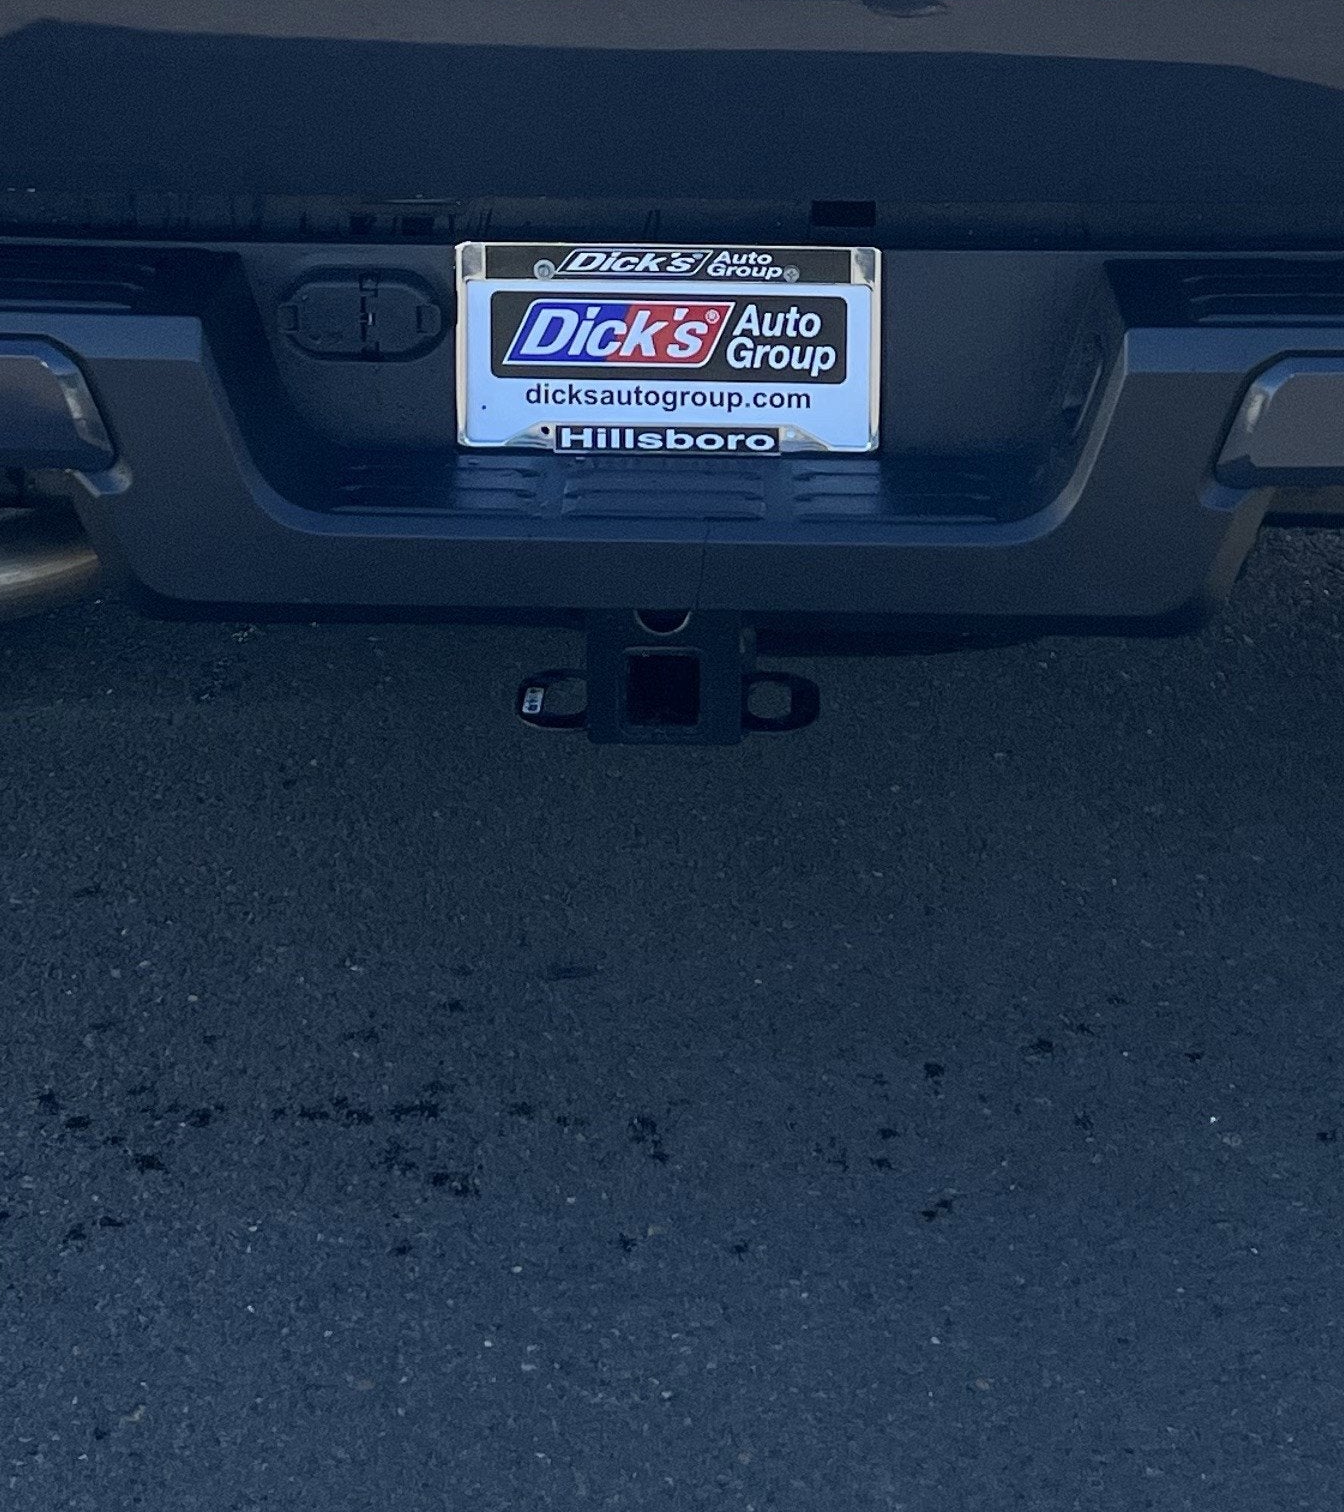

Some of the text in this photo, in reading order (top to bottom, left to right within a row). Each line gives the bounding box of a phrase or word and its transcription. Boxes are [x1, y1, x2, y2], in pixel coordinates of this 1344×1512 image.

[566, 250, 704, 274] Dick's
[706, 262, 783, 280] Group
[713, 251, 773, 266] Auto
[731, 305, 823, 339] Auto
[725, 337, 837, 377] Group
[525, 383, 812, 412] dicksautogroup.com
[560, 427, 776, 453] Hillsboro
